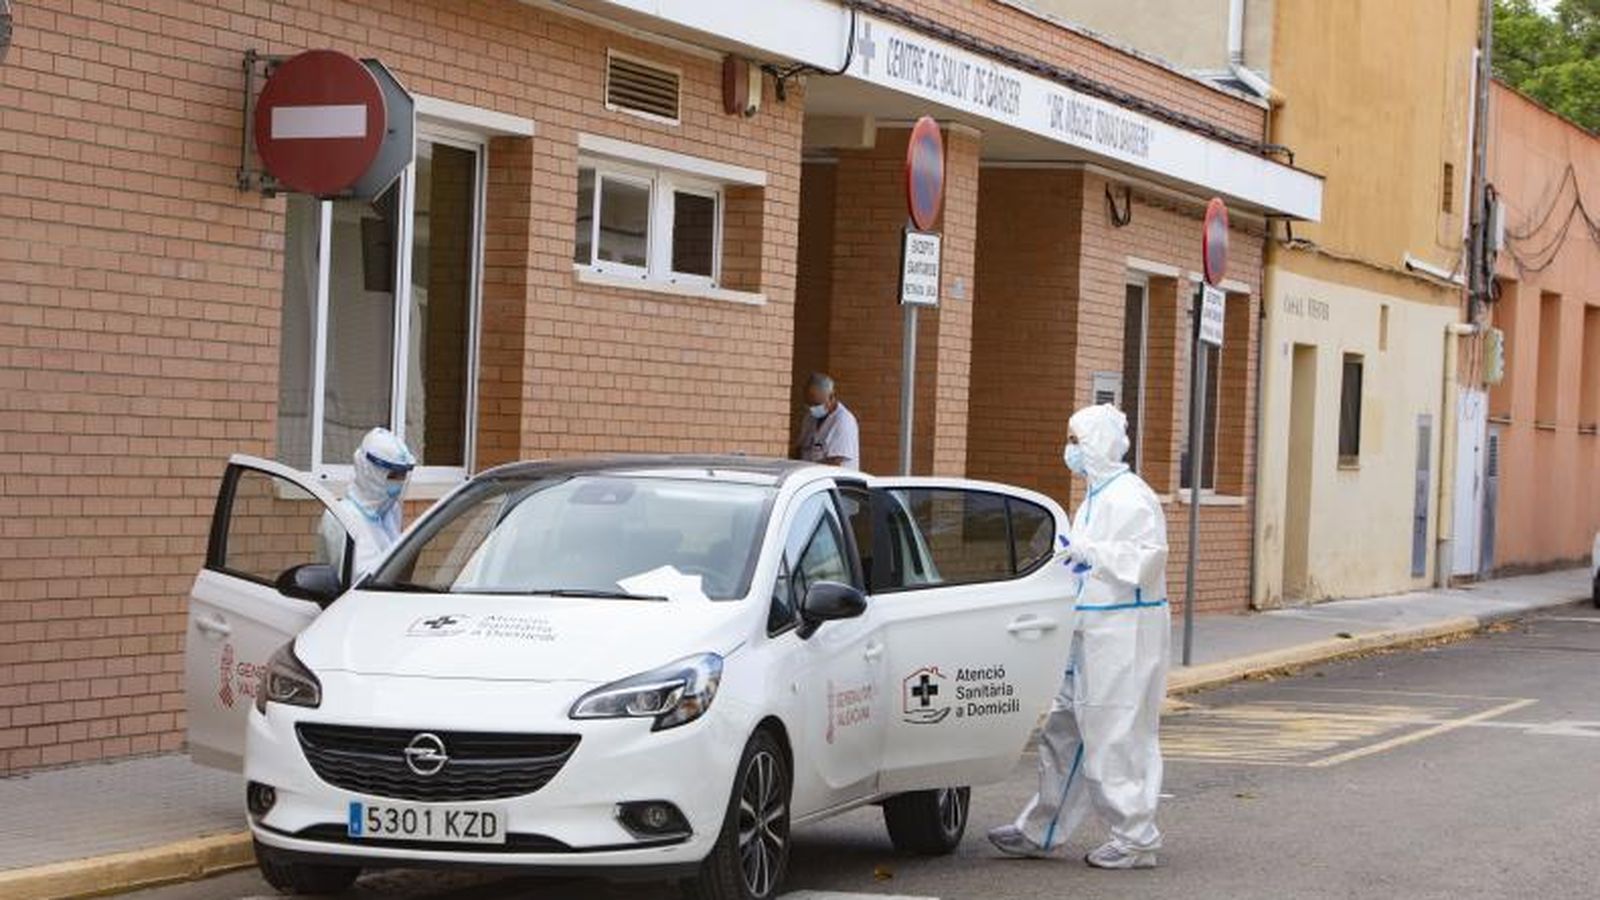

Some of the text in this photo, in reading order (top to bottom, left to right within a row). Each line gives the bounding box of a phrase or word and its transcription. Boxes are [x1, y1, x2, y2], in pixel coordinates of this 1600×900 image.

[886, 37, 926, 85] CENTRE
[926, 50, 940, 90] DE
[955, 664, 1006, 682] Atenció
[955, 683, 1014, 701] Sanitària
[955, 698, 1021, 718] a Domicili
[367, 806, 497, 839] 5301 KZD
